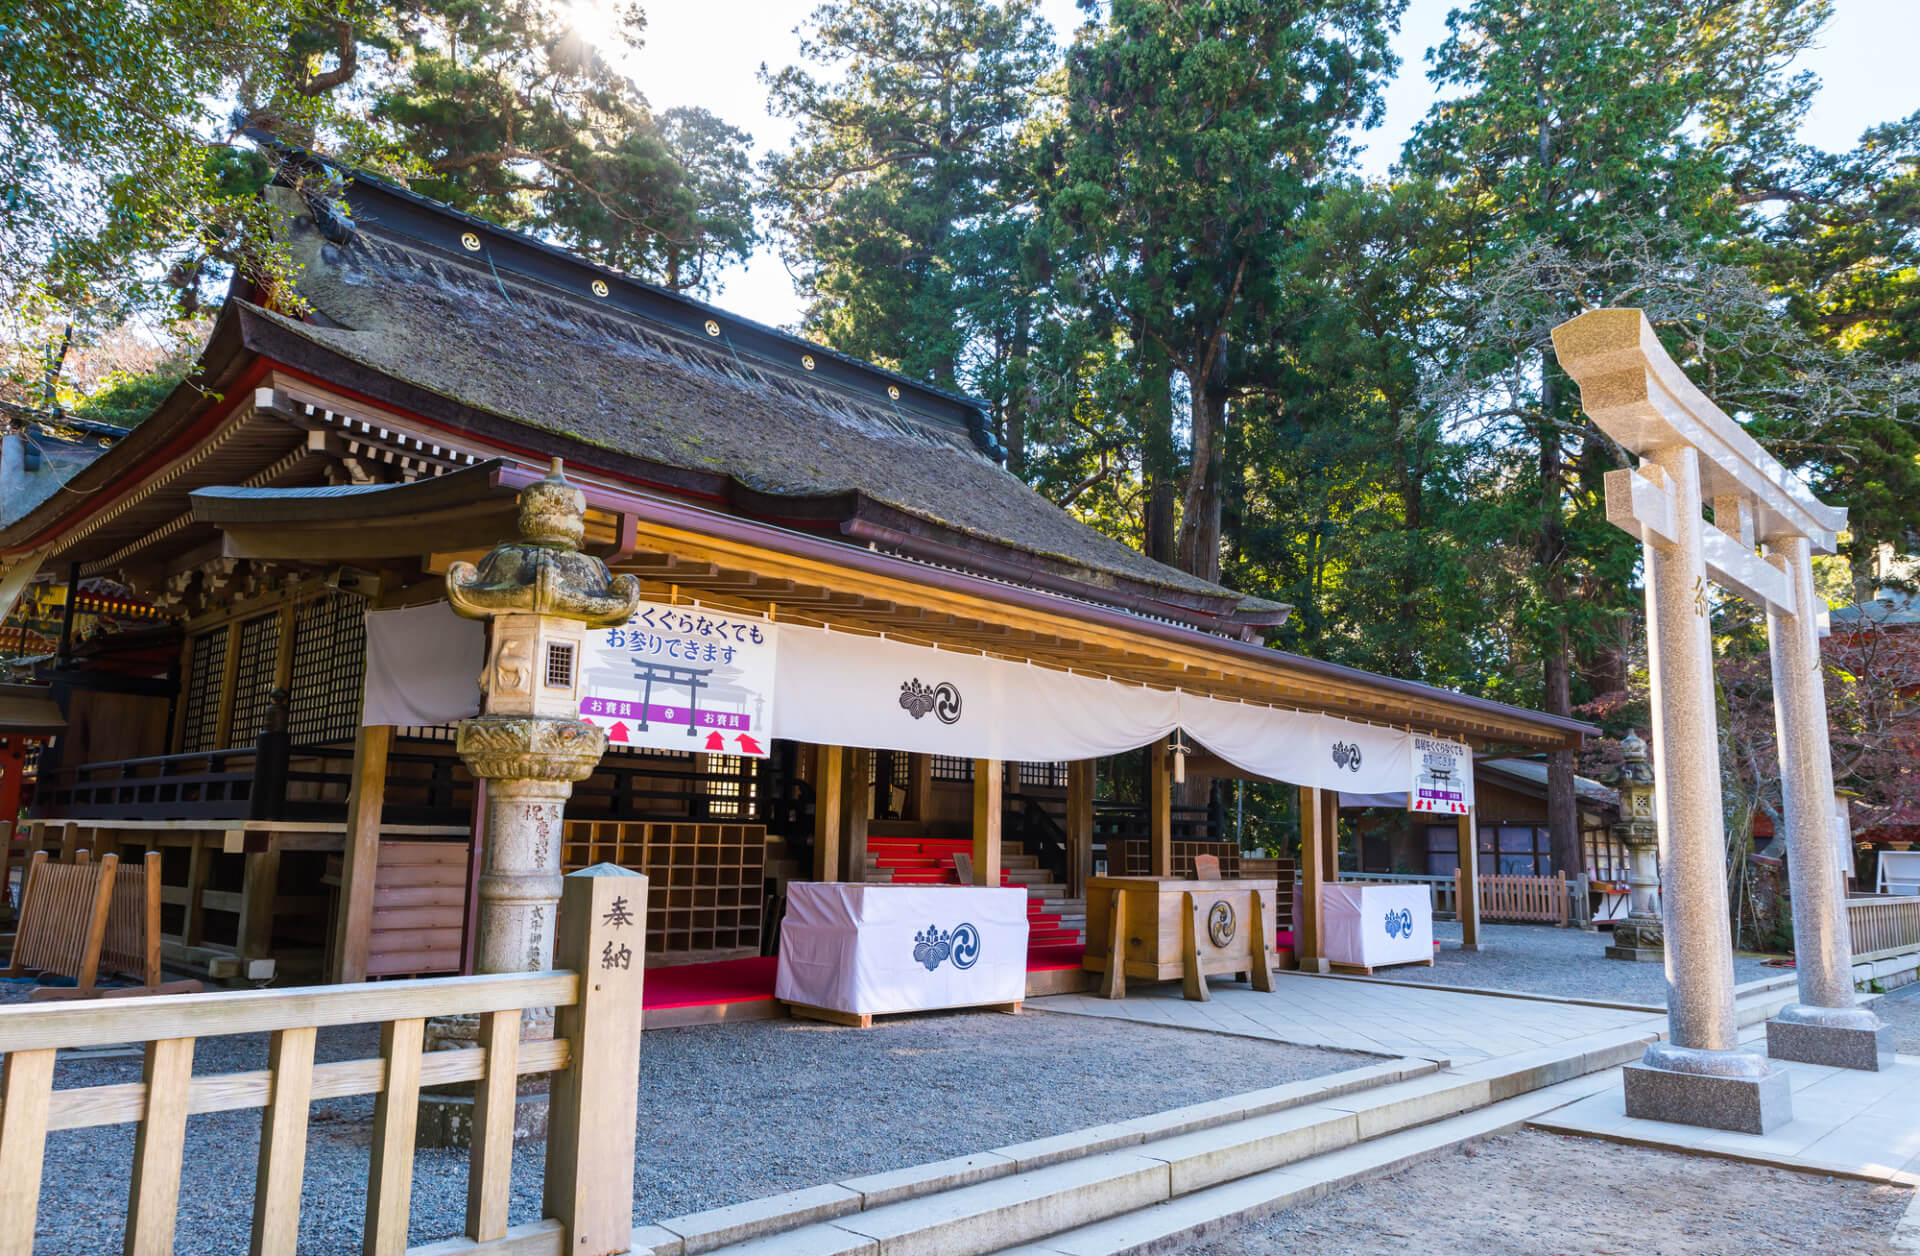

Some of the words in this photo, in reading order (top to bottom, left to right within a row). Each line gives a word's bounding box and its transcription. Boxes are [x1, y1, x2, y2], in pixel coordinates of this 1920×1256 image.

[606, 628, 737, 665] お参りできます
[590, 700, 632, 716] お賽銭
[602, 896, 634, 970] 奉納
